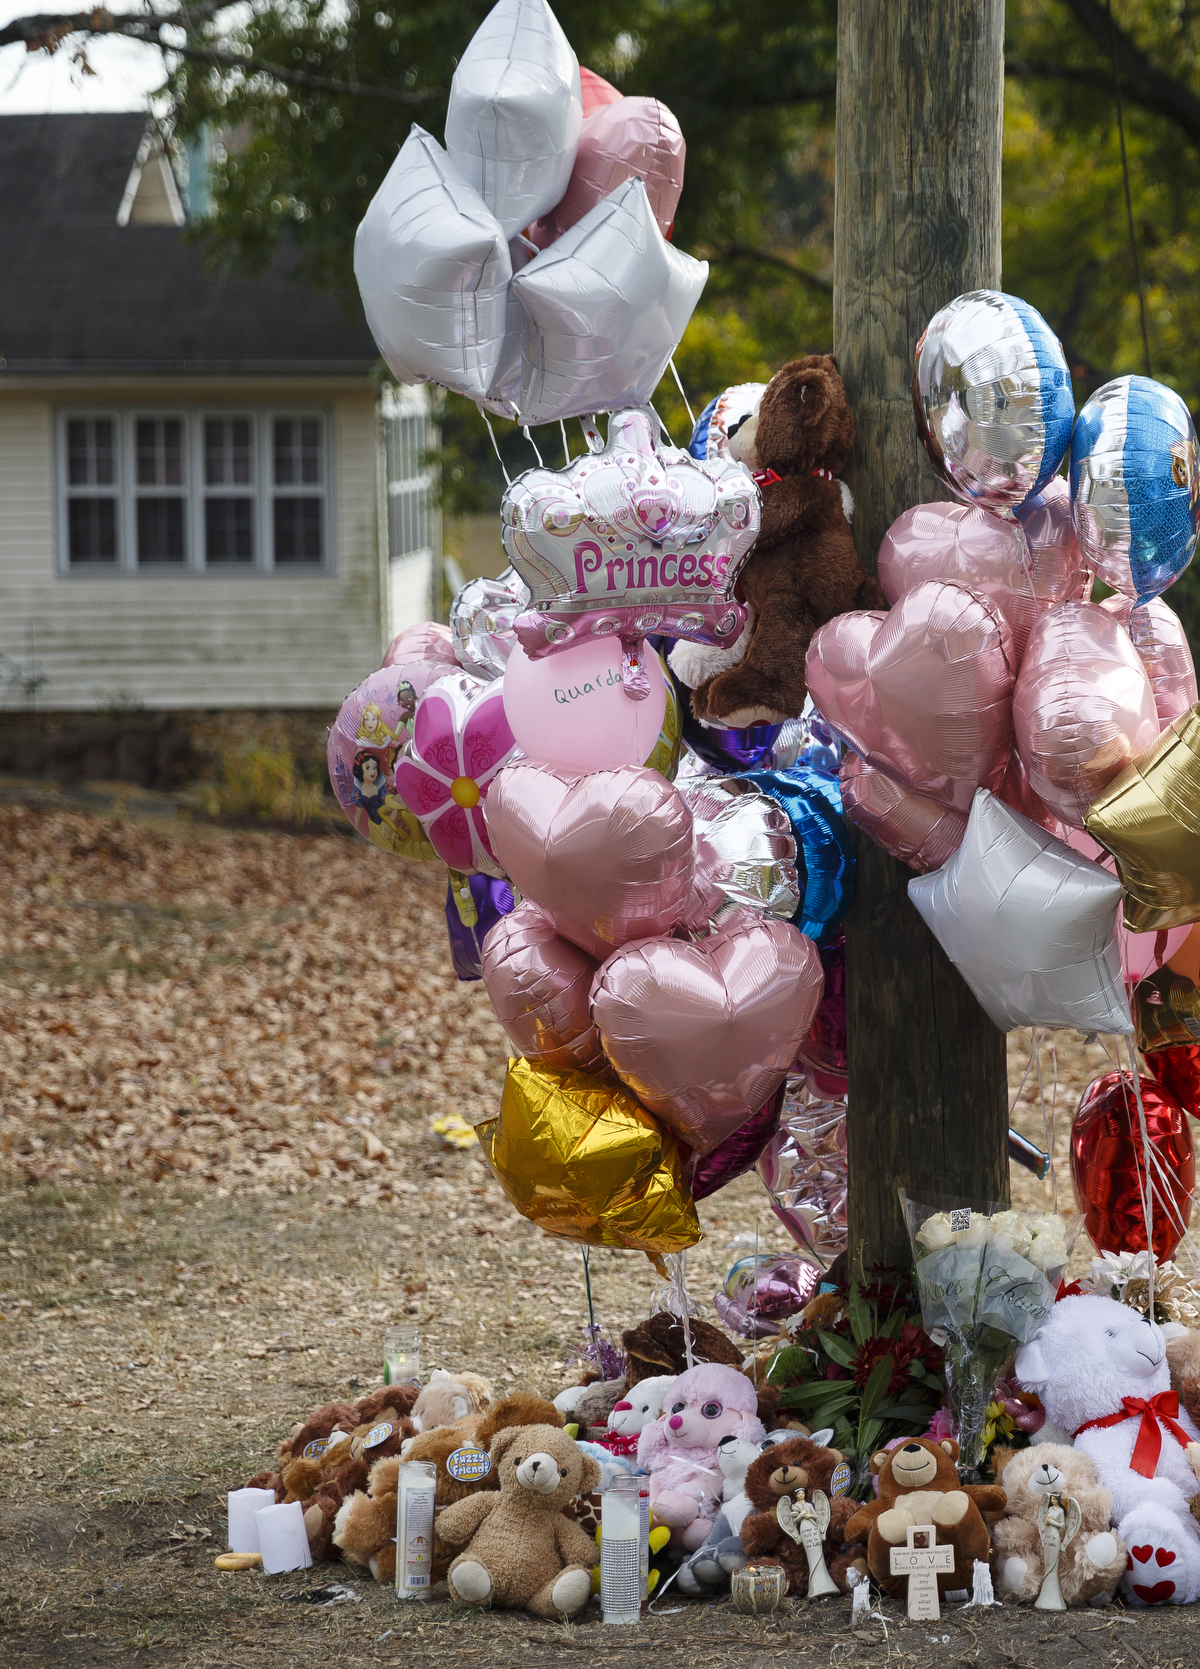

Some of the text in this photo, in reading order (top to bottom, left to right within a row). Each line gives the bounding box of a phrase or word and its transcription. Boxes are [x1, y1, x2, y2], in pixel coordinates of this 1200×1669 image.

[573, 540, 734, 594] Princess
[453, 1453, 485, 1465] Fuzzy
[452, 1463, 489, 1476] Friends
[894, 1555, 951, 1566] LOVE
